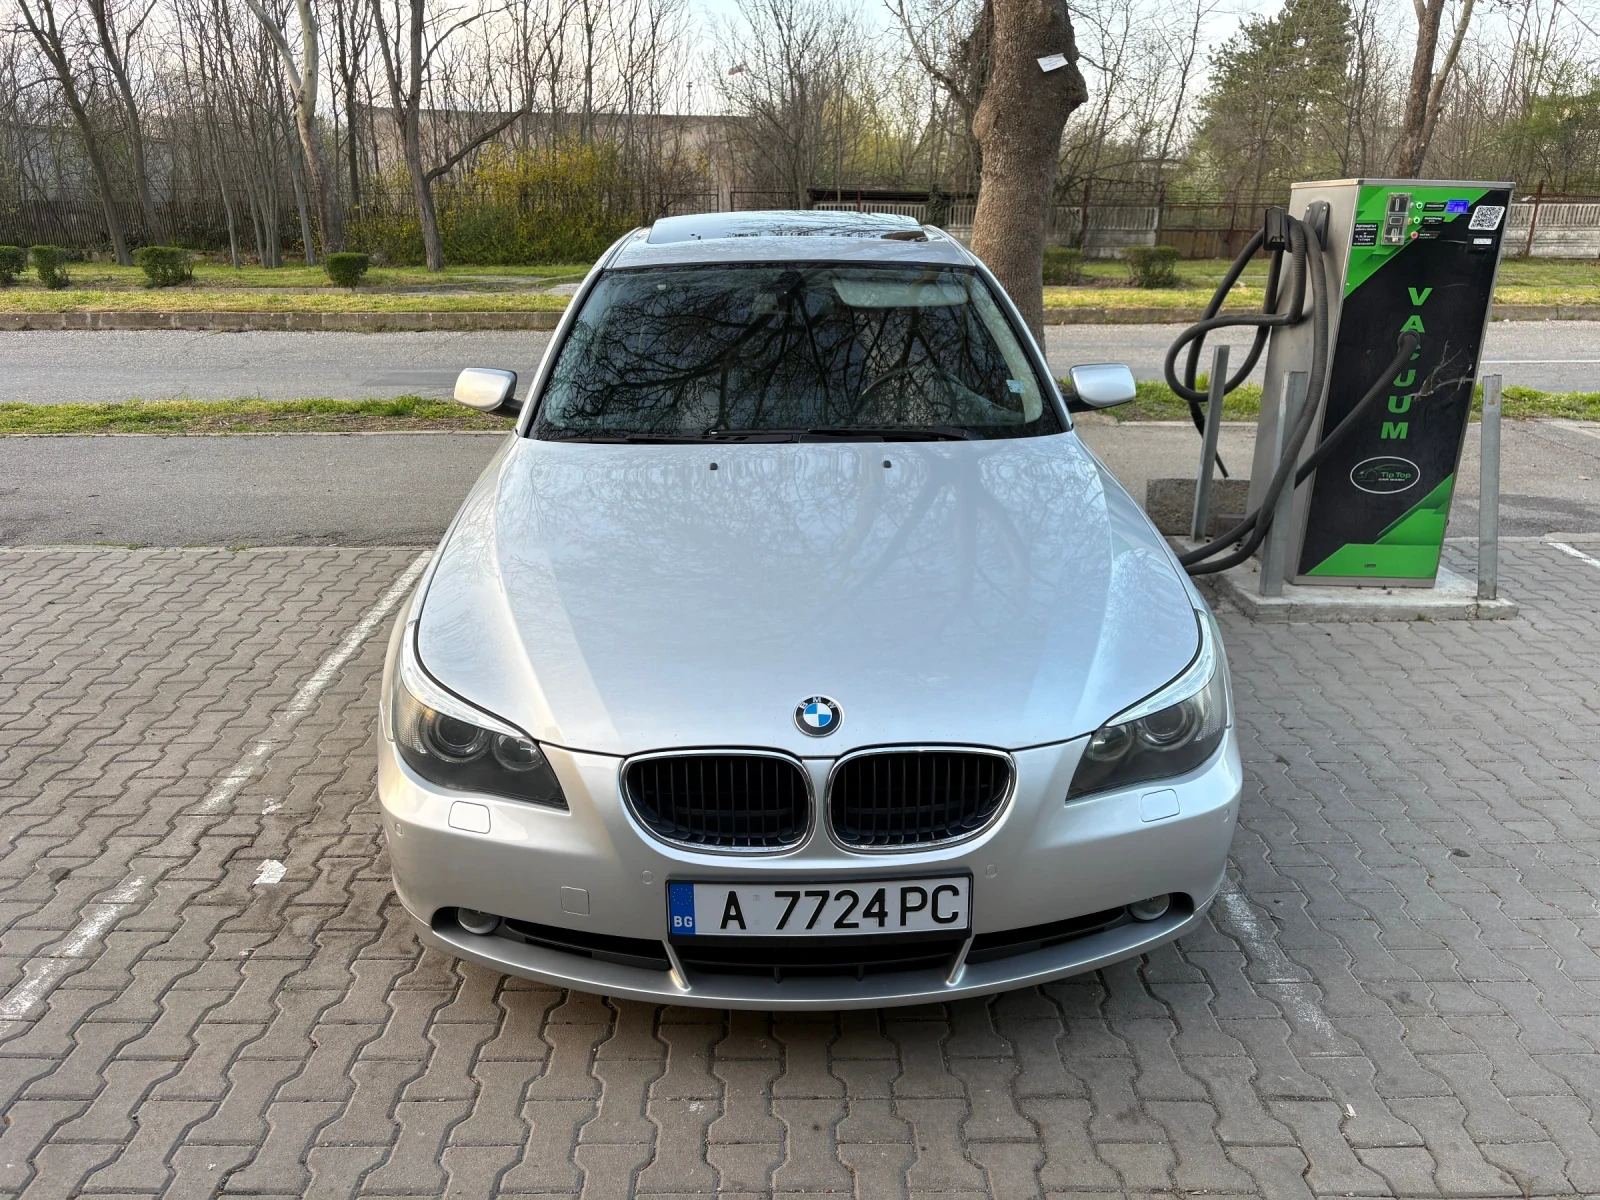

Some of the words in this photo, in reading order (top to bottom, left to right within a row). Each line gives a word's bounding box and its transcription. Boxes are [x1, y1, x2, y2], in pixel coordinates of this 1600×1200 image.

[1381, 287, 1433, 439] VAUUM
[1396, 471, 1411, 479] Top
[800, 696, 837, 709] BMW
[720, 890, 747, 930] A
[673, 915, 693, 928] BG
